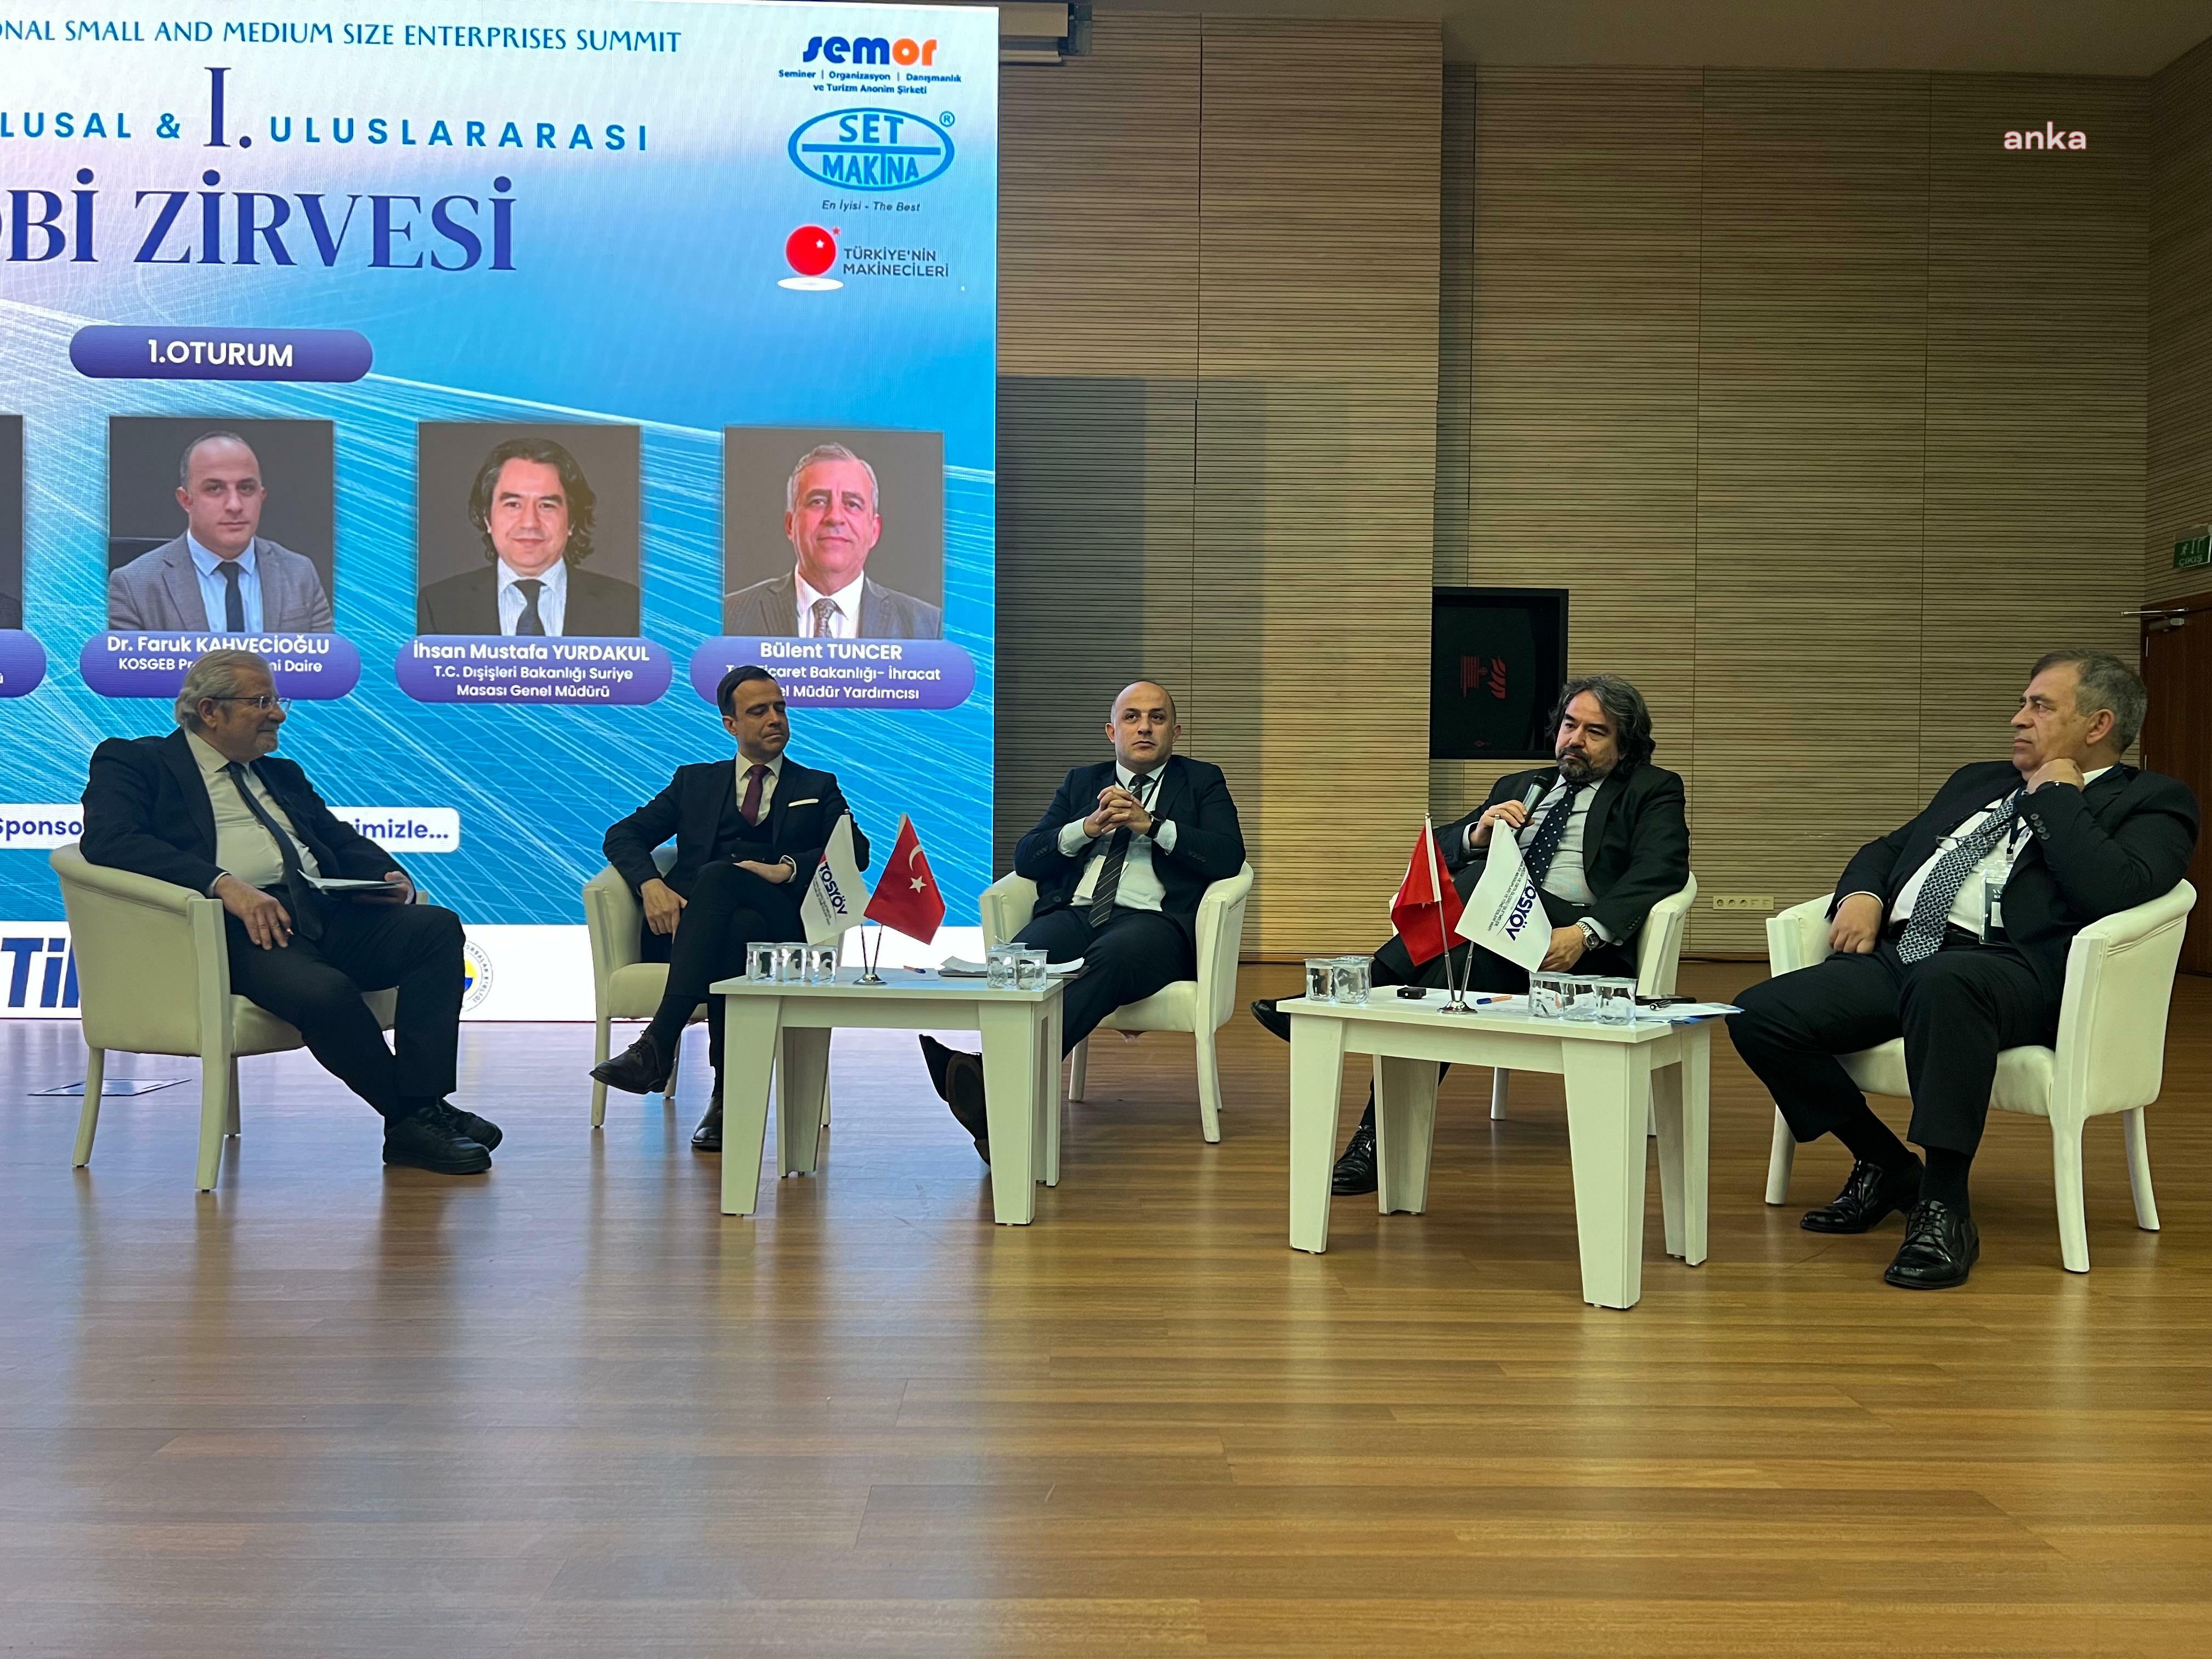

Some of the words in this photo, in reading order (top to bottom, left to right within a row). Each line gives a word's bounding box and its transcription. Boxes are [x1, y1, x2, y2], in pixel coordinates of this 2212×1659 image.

[0, 20, 55, 41] NAL
[65, 20, 144, 42] SMALL
[155, 21, 212, 42] AND
[224, 22, 332, 43] MEDIUM
[343, 24, 393, 45] SIZE
[405, 25, 566, 49] ENTERPRISES
[577, 30, 681, 52] SUMMIT
[803, 36, 937, 66] semor
[778, 69, 816, 78] Seminer
[829, 70, 890, 81] Organizasyon
[827, 83, 857, 92] Turizm
[860, 84, 894, 93] Anonim
[898, 86, 927, 94] Şirketi
[156, 114, 180, 138] &
[203, 66, 252, 149] I.
[270, 116, 646, 151] ULUSLARARASI
[839, 114, 904, 144] SET
[822, 200, 836, 210] En
[873, 201, 893, 211] The
[896, 202, 921, 212] Best
[0, 168, 99, 262] Bİ
[134, 170, 517, 272] ZİRVESİ
[844, 246, 936, 261] TÜRKİYE'NİN
[843, 262, 949, 276] MAKİNECİLERİ
[148, 339, 293, 366] 1.OTURUM
[2179, 554, 2203, 568] ÇIKIŞ
[108, 636, 132, 651] Dr.
[138, 636, 191, 652] Faruk
[196, 635, 329, 654] KAHVECİOĞLU
[414, 640, 465, 658] İhsan
[471, 644, 548, 660] Mustafa
[552, 645, 650, 661] YURDAKUL
[761, 642, 822, 658] Bülent
[827, 644, 902, 660] TUNCER
[119, 659, 174, 670] KOSGEB
[179, 659, 196, 670] Pr
[284, 661, 323, 672] Daire
[434, 665, 460, 678] T.C.
[463, 665, 516, 682] Dışişleri
[521, 667, 585, 682] Bakanlığı
[589, 668, 633, 681] Suriye
[889, 665, 940, 680] İhracat
[457, 685, 507, 696] Masası
[510, 685, 551, 697] Genel
[555, 685, 610, 697] Müdürü
[793, 685, 840, 698] Müdür
[843, 687, 919, 699] Yardımcısı
[819, 861, 848, 915] TOSYÖV
